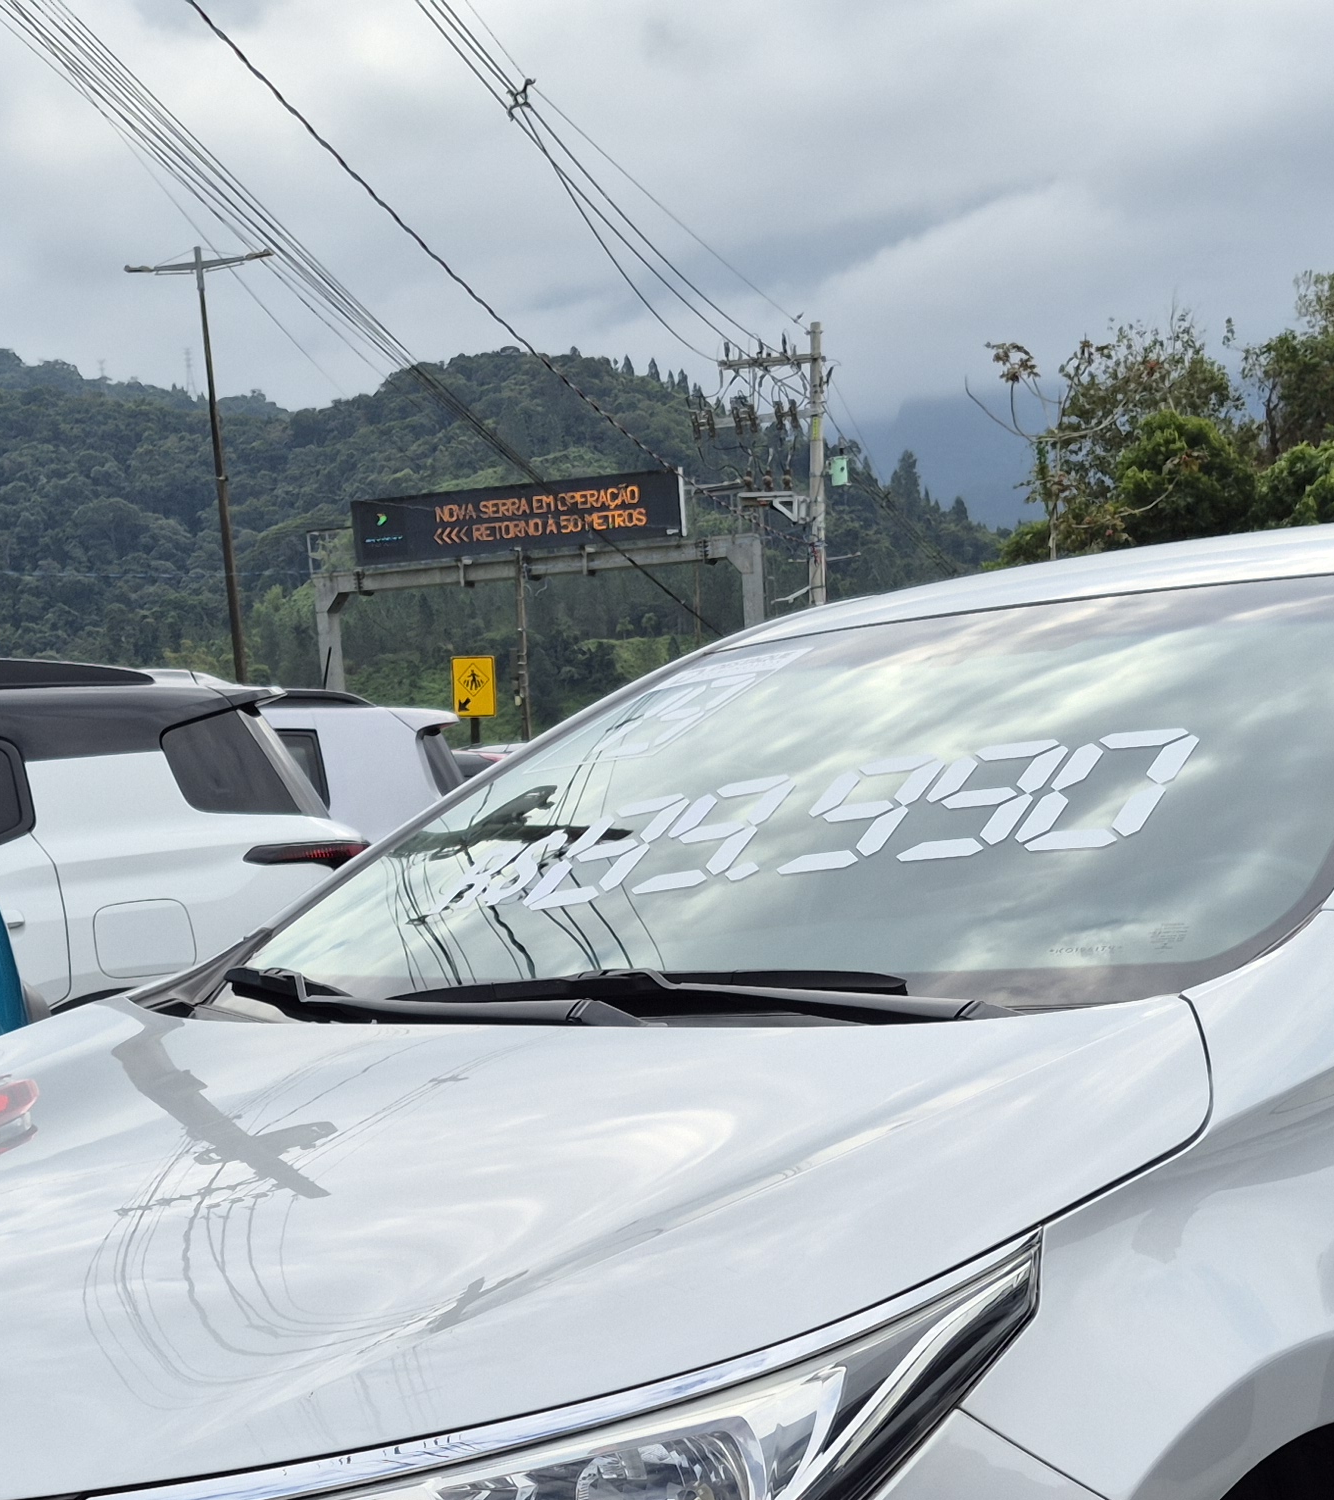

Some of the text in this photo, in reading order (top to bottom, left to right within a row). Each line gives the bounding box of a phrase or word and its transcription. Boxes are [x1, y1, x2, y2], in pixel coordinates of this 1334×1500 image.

[435, 483, 640, 523] NOVA SERRA EM OPERAÇÃO
[472, 518, 543, 542] RETORNO
[560, 515, 582, 534] 50
[584, 507, 648, 532] METROS
